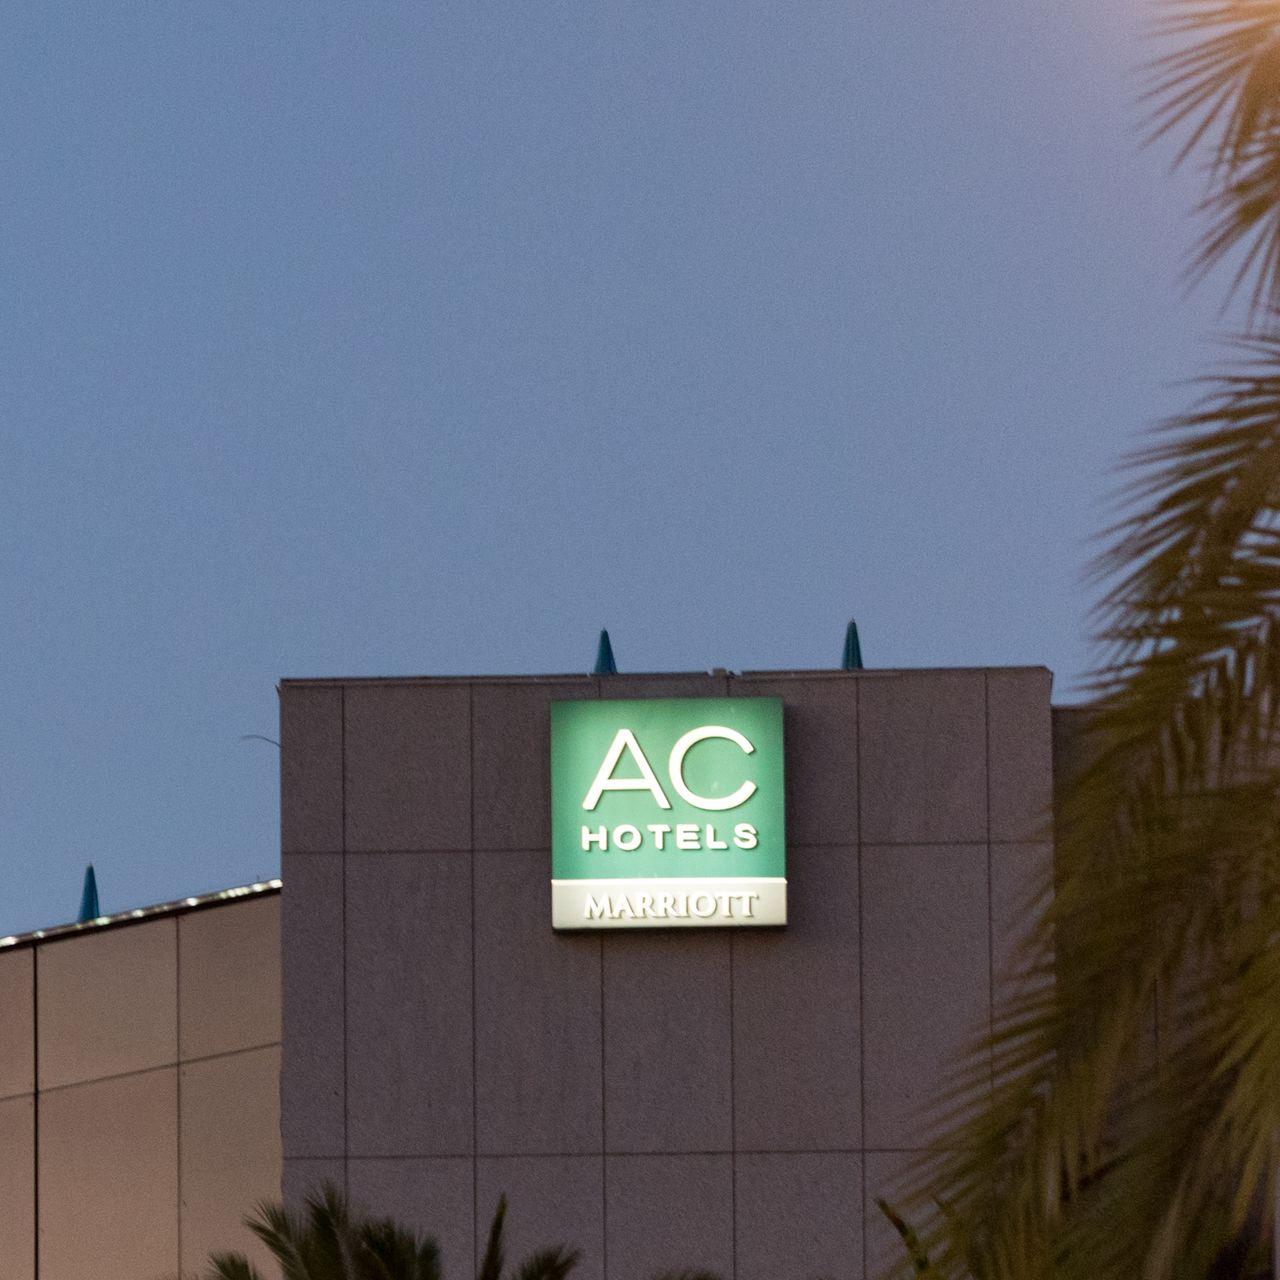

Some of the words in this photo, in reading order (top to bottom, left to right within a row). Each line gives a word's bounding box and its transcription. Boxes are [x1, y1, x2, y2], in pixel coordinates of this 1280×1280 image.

[582, 725, 758, 811] AC
[580, 823, 759, 851] HOTELS
[583, 891, 759, 920] MARRIOTT
